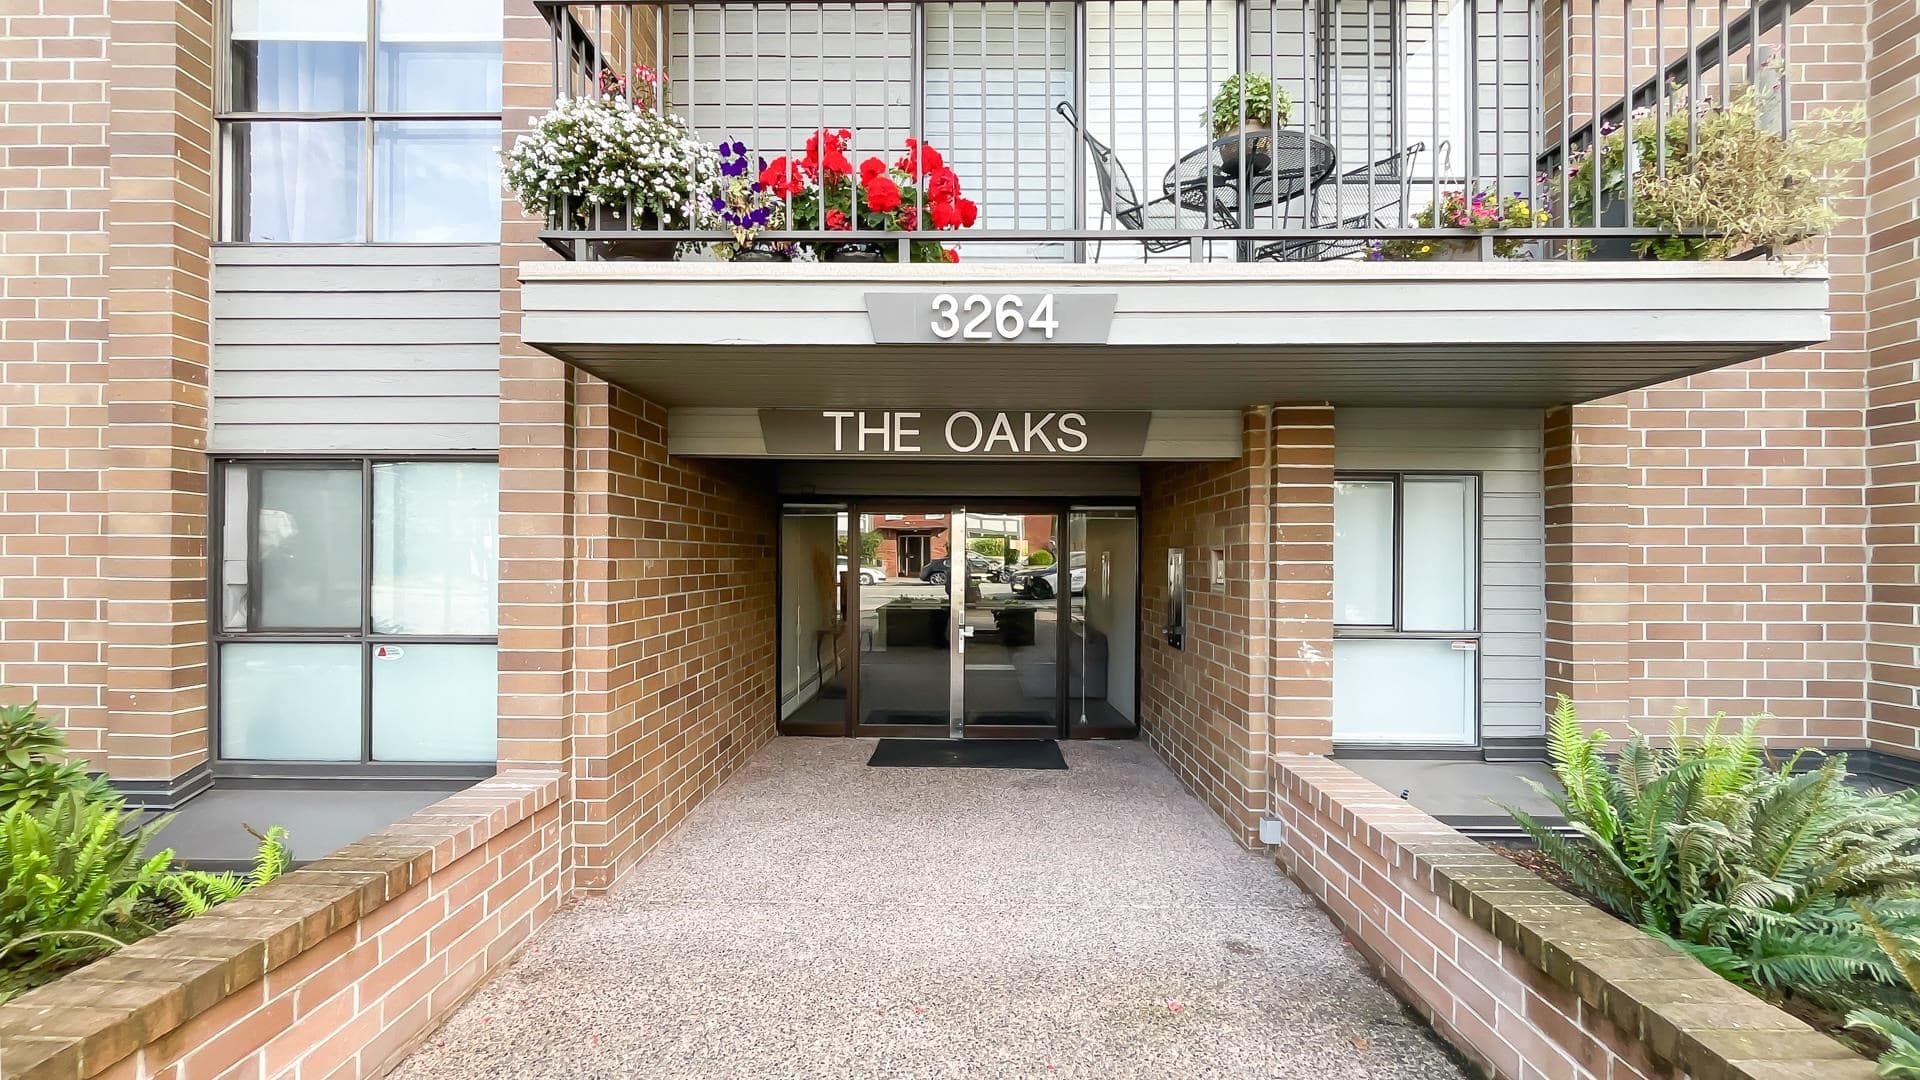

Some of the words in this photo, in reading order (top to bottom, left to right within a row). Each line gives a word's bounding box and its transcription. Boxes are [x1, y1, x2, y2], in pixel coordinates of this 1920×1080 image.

[930, 293, 1059, 339] 3264
[823, 411, 921, 452] THE
[945, 411, 1088, 452] OAKS
